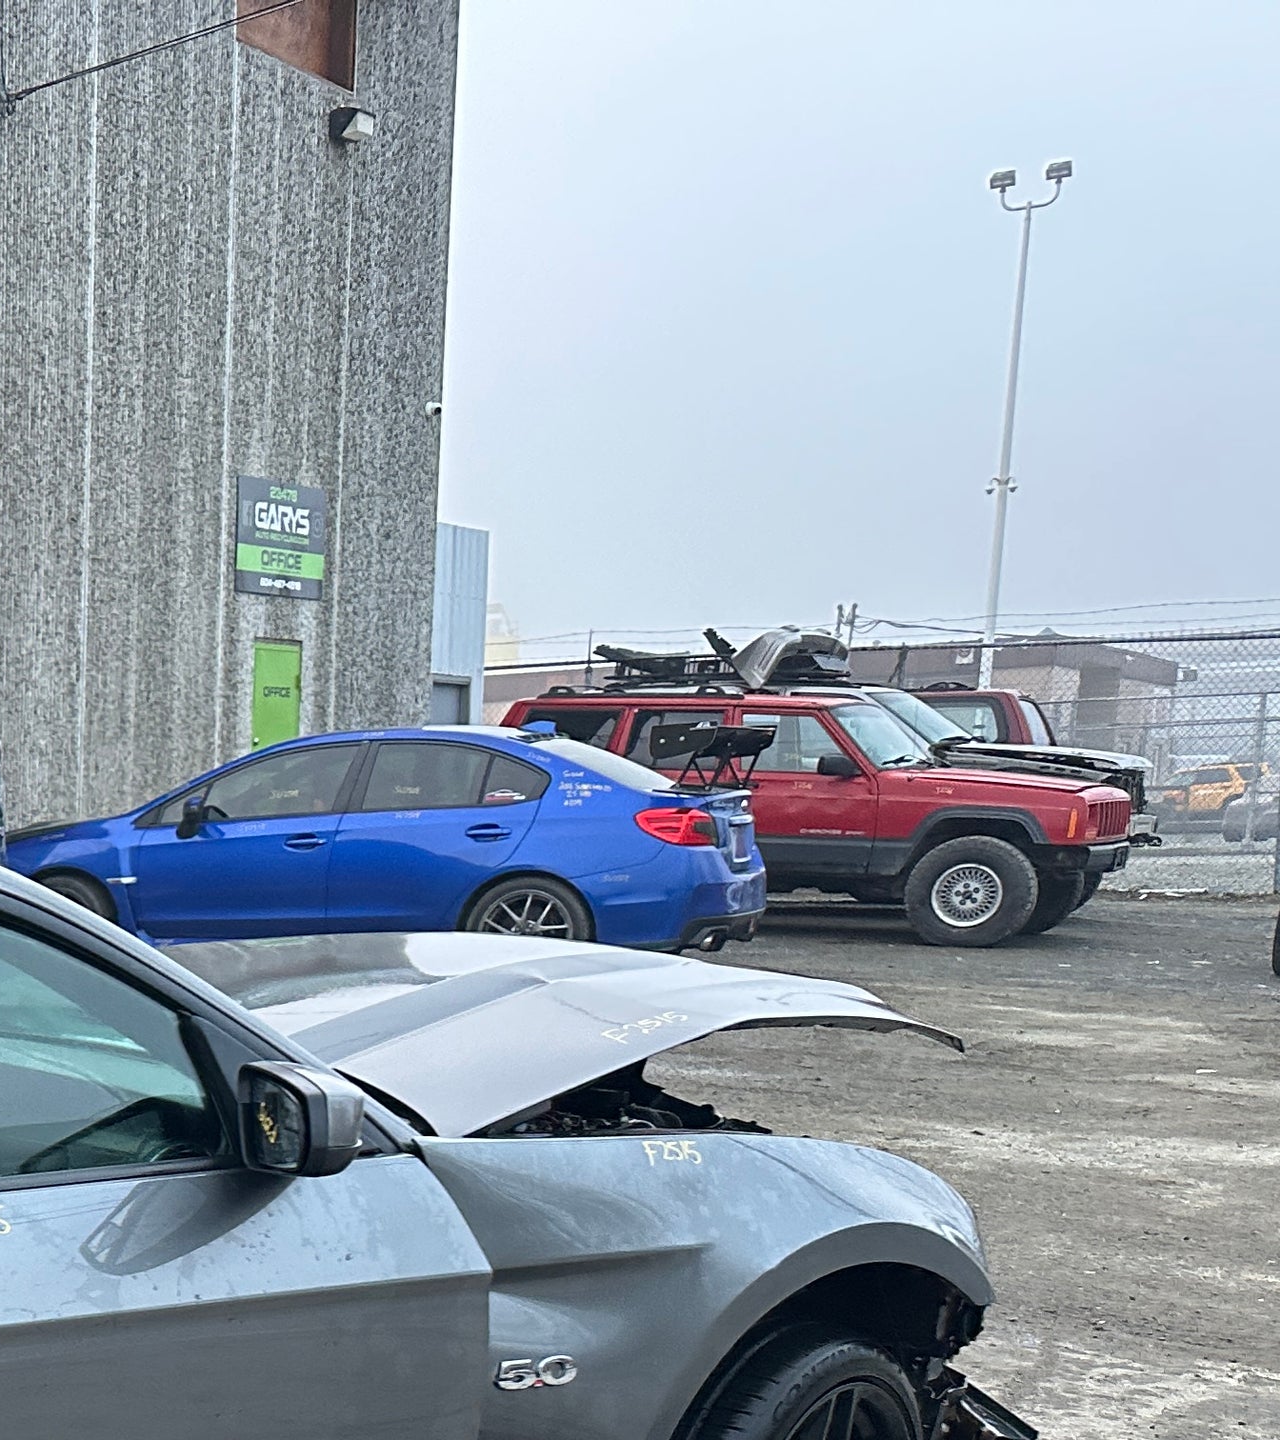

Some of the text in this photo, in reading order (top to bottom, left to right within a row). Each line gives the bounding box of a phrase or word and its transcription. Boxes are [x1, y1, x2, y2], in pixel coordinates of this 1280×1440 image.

[255, 501, 310, 536] GARYS
[261, 550, 302, 570] OFFICE
[493, 1354, 578, 1391] 5.0
